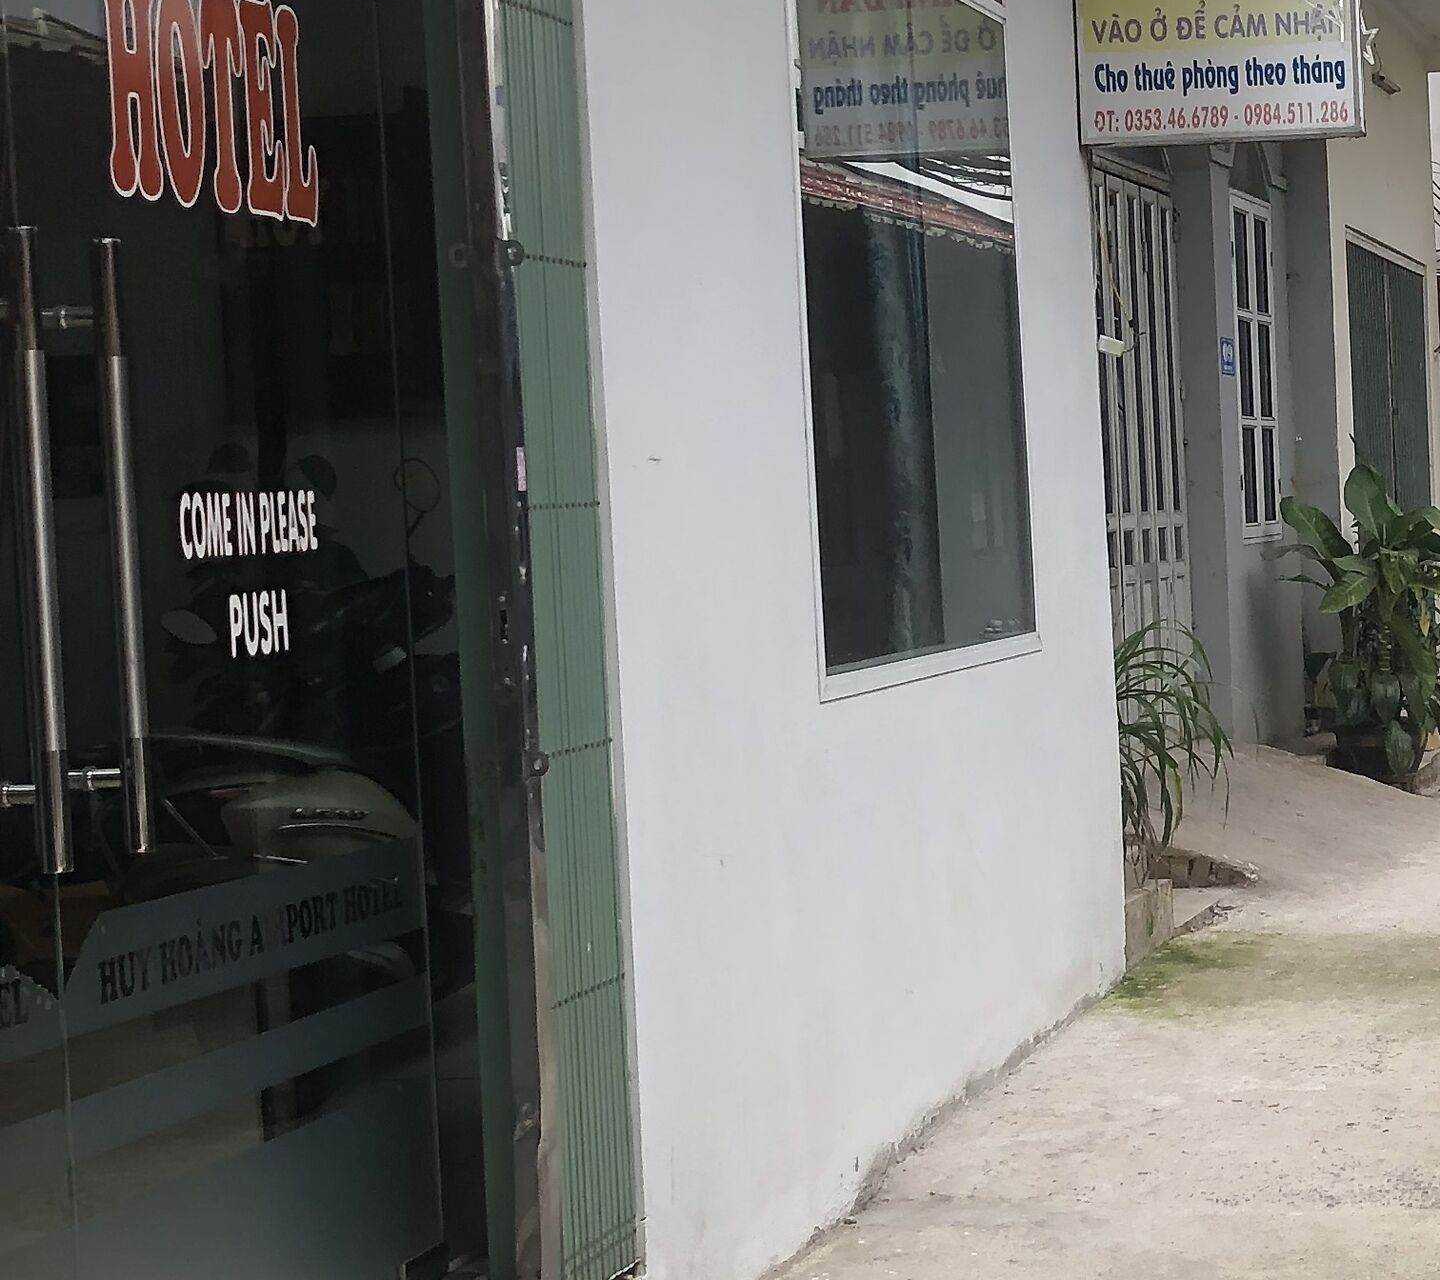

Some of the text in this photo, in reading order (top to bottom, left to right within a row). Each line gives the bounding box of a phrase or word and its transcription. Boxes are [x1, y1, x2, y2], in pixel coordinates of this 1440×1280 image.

[1092, 13, 1142, 45] VÀO
[1150, 7, 1168, 42] Ở
[1176, 0, 1207, 41] ĐỂ
[1214, 3, 1268, 39] CẢM
[1094, 54, 1345, 96] Cho thuê phòng theo tháng
[1124, 104, 1230, 131] 0353.46.6789
[1243, 100, 1348, 127] 0984.511.286
[179, 489, 318, 560] COME IN PLEASE
[229, 588, 289, 659] PUSH
[98, 944, 153, 1005] HUY
[249, 891, 339, 957] APORT
